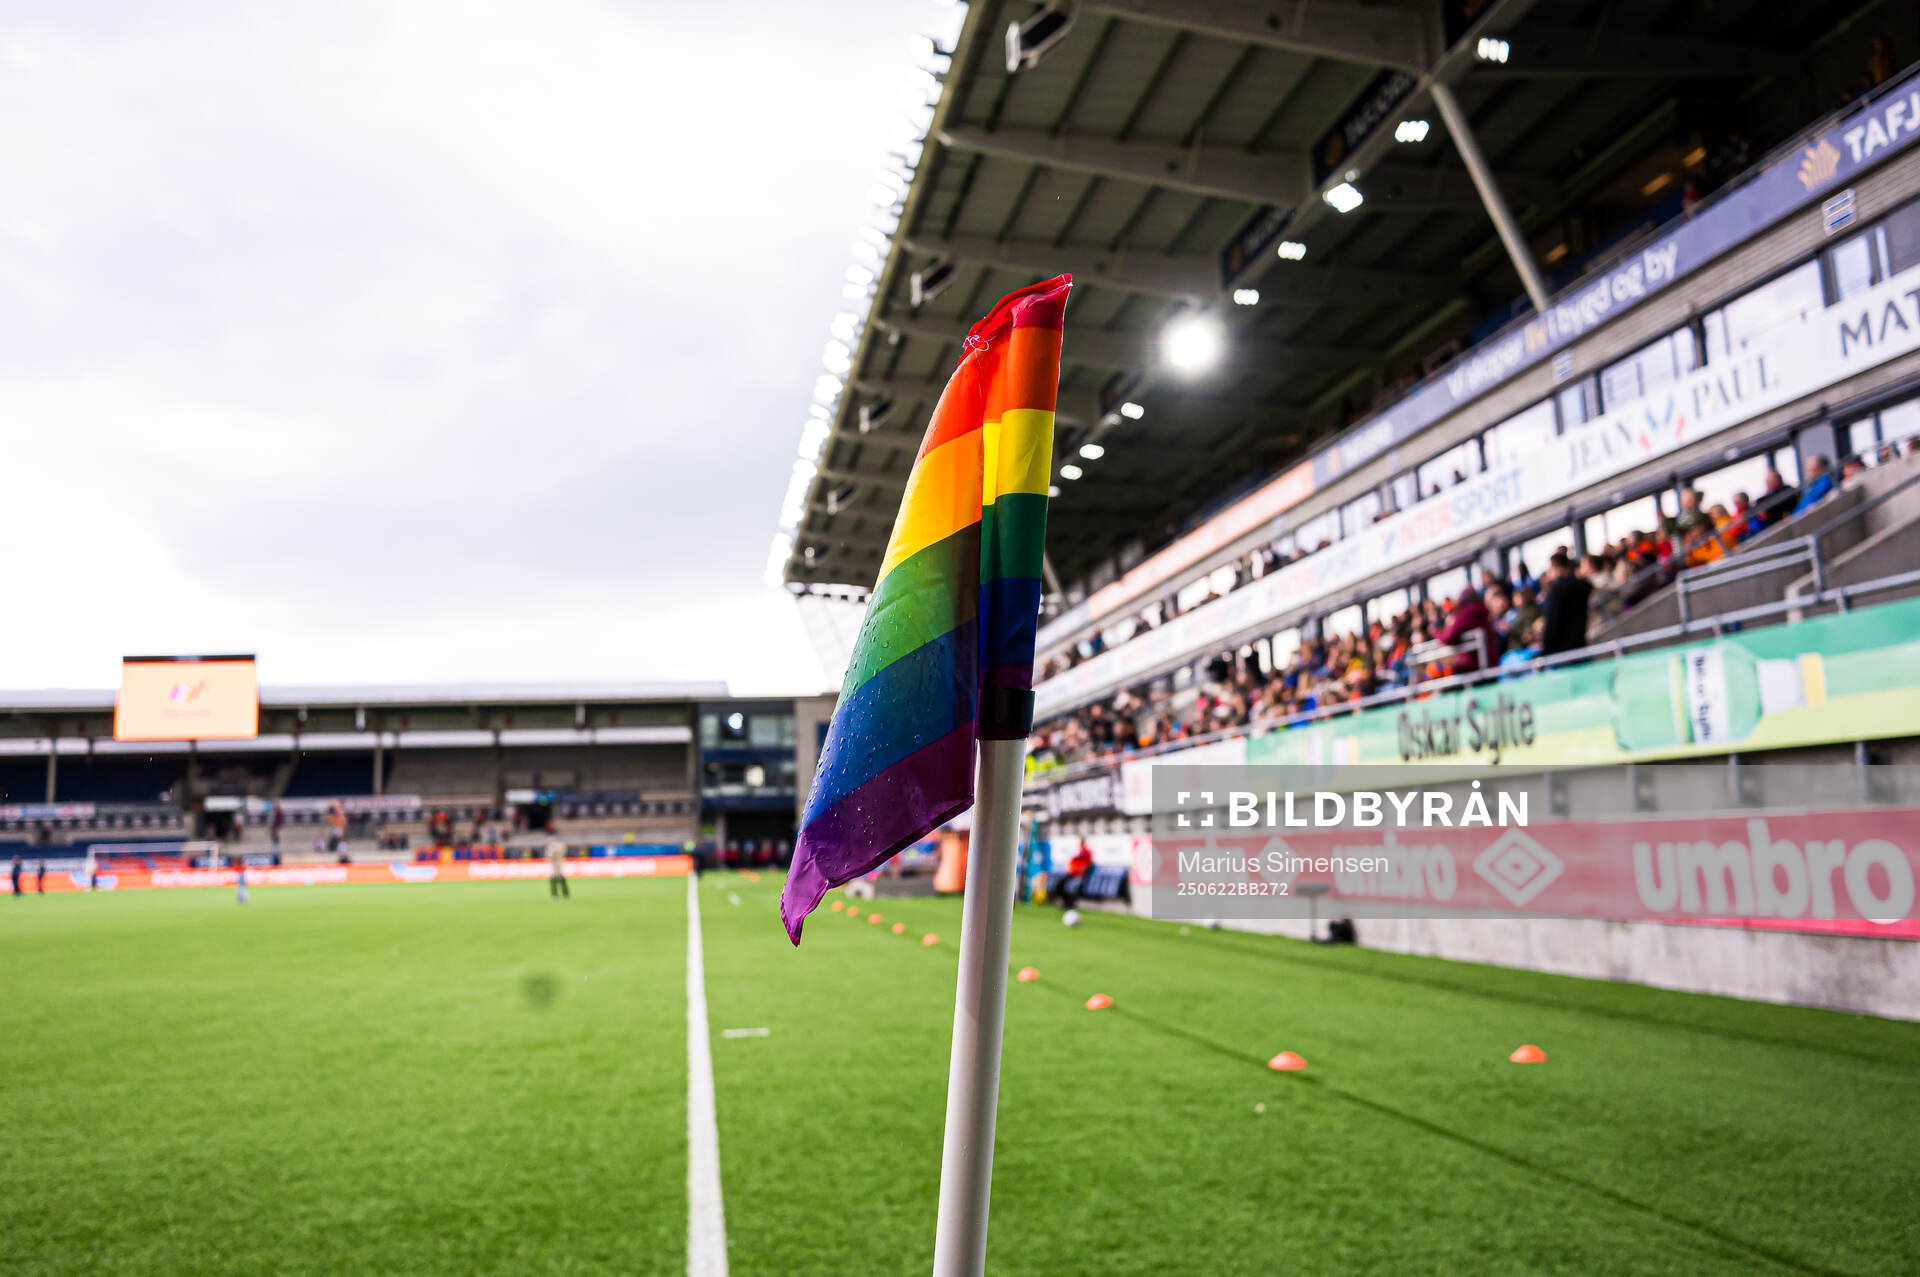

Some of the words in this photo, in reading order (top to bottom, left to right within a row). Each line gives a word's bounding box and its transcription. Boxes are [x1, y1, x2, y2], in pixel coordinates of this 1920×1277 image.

[1611, 262, 1645, 303] og
[1643, 241, 1679, 284] by
[1568, 420, 1633, 478] JEAN
[1690, 354, 1780, 420] PAUL
[1633, 817, 1915, 925] umbro
